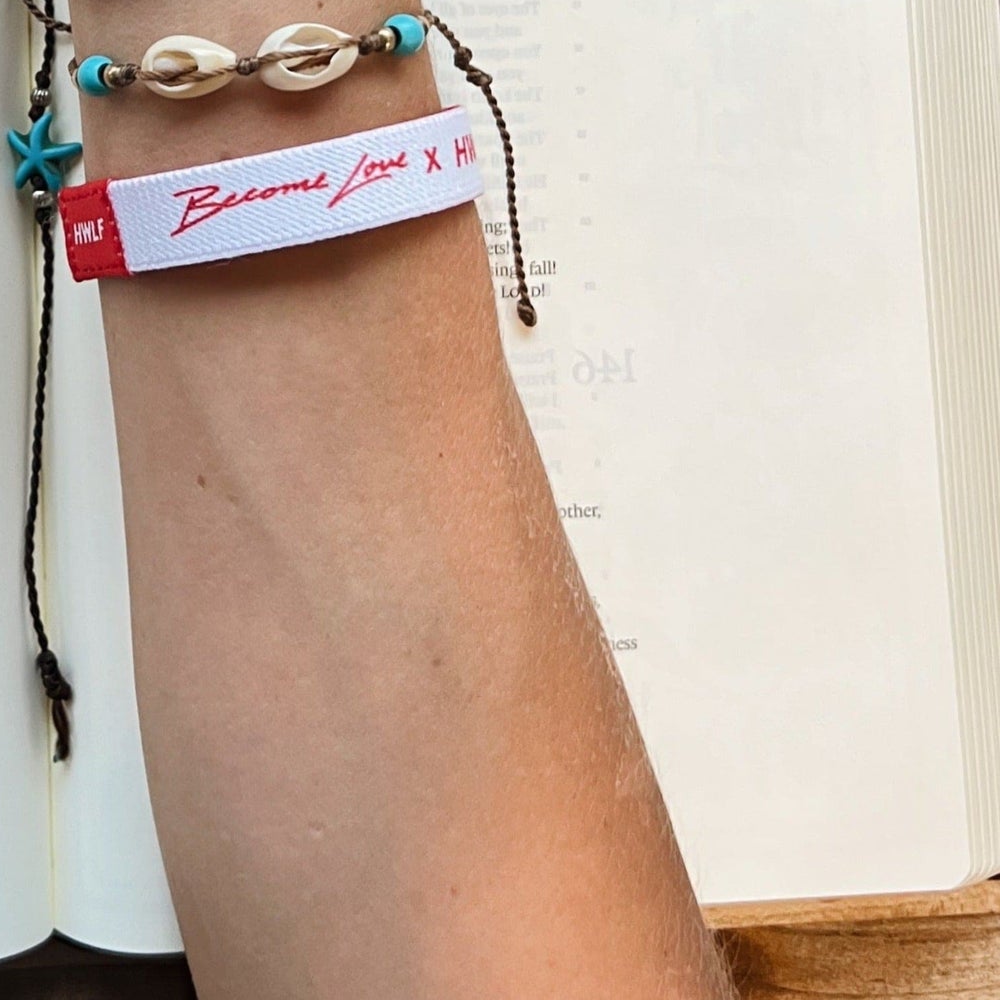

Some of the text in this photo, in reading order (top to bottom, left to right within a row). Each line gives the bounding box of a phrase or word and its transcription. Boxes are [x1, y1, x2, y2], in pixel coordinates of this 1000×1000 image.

[170, 172, 329, 237] Become
[328, 151, 407, 208] Love
[73, 218, 105, 245] HWLF
[529, 260, 557, 276] fall!
[501, 283, 545, 299] LOD!
